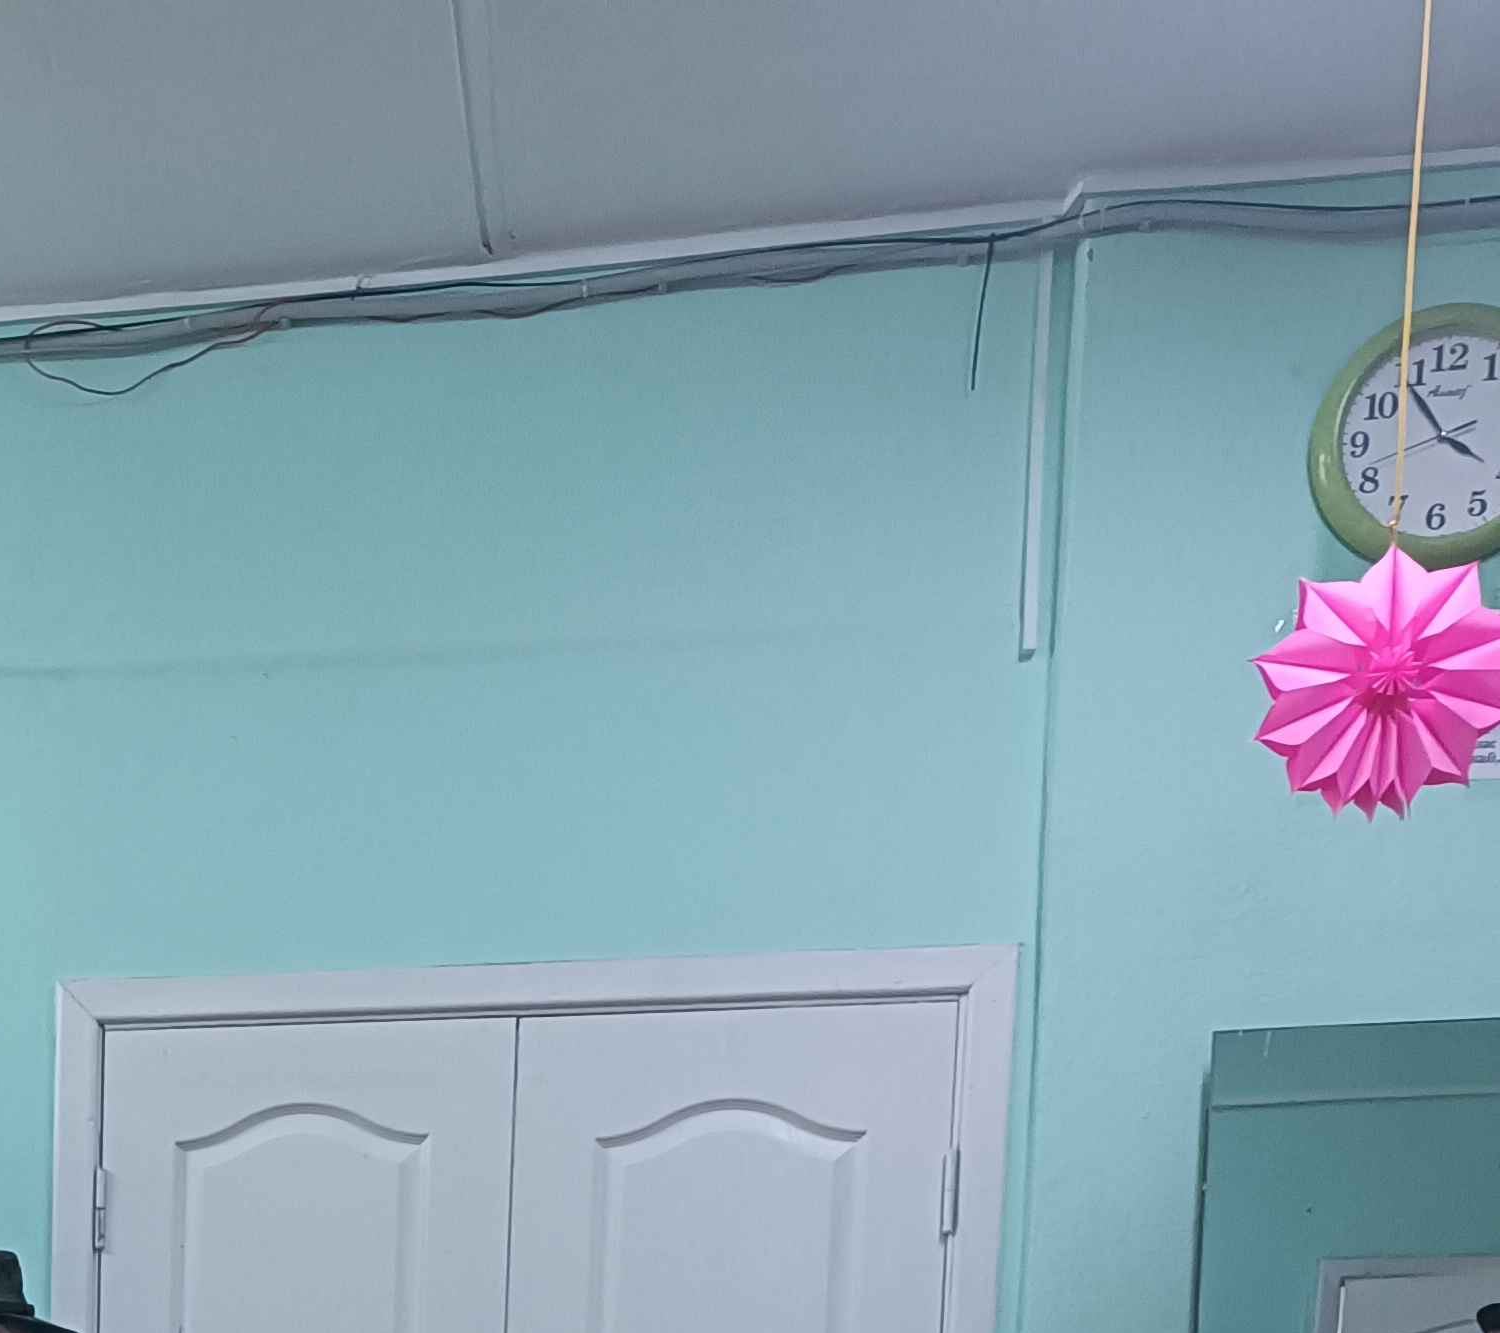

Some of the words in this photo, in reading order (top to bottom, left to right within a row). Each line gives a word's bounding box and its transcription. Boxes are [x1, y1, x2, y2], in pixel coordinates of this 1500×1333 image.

[1431, 343, 1469, 372] 12
[1483, 354, 1498, 381] 1
[1364, 391, 1398, 420] 10
[1350, 431, 1369, 458] 9
[1359, 467, 1379, 493] 8
[1426, 503, 1445, 530] 6
[1467, 490, 1487, 516] 5
